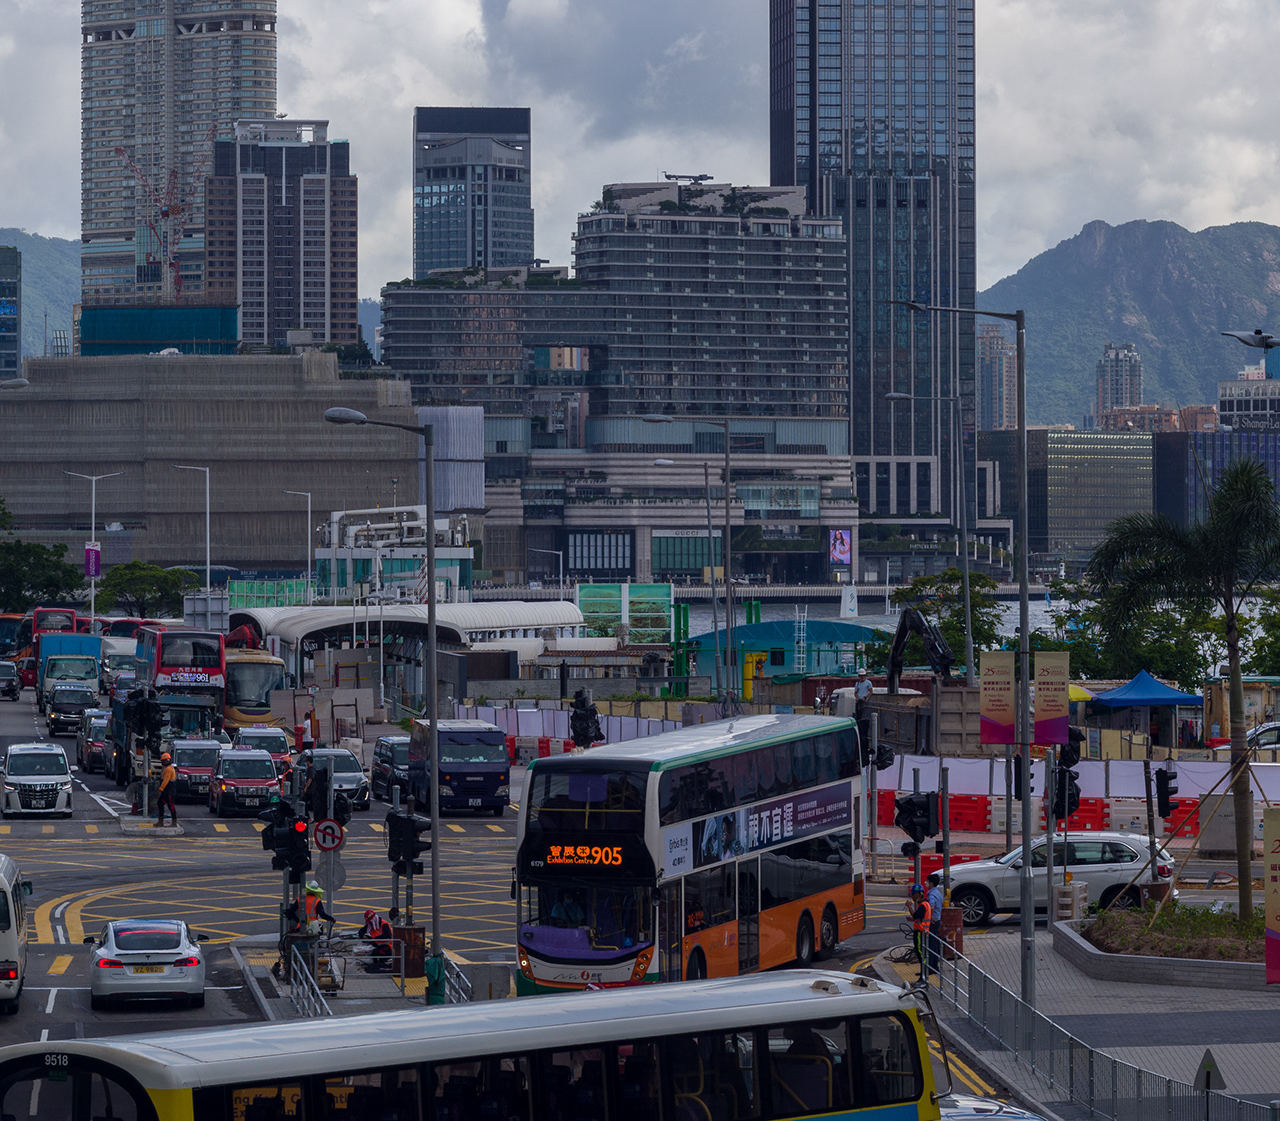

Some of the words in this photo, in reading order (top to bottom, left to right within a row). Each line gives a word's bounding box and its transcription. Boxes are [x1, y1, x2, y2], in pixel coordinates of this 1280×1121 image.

[771, 488, 802, 508] K11
[195, 673, 210, 682] 961
[547, 856, 574, 864] Exhibition
[574, 856, 594, 864] Centre
[591, 846, 623, 865] 905
[44, 1055, 69, 1067] 9518
